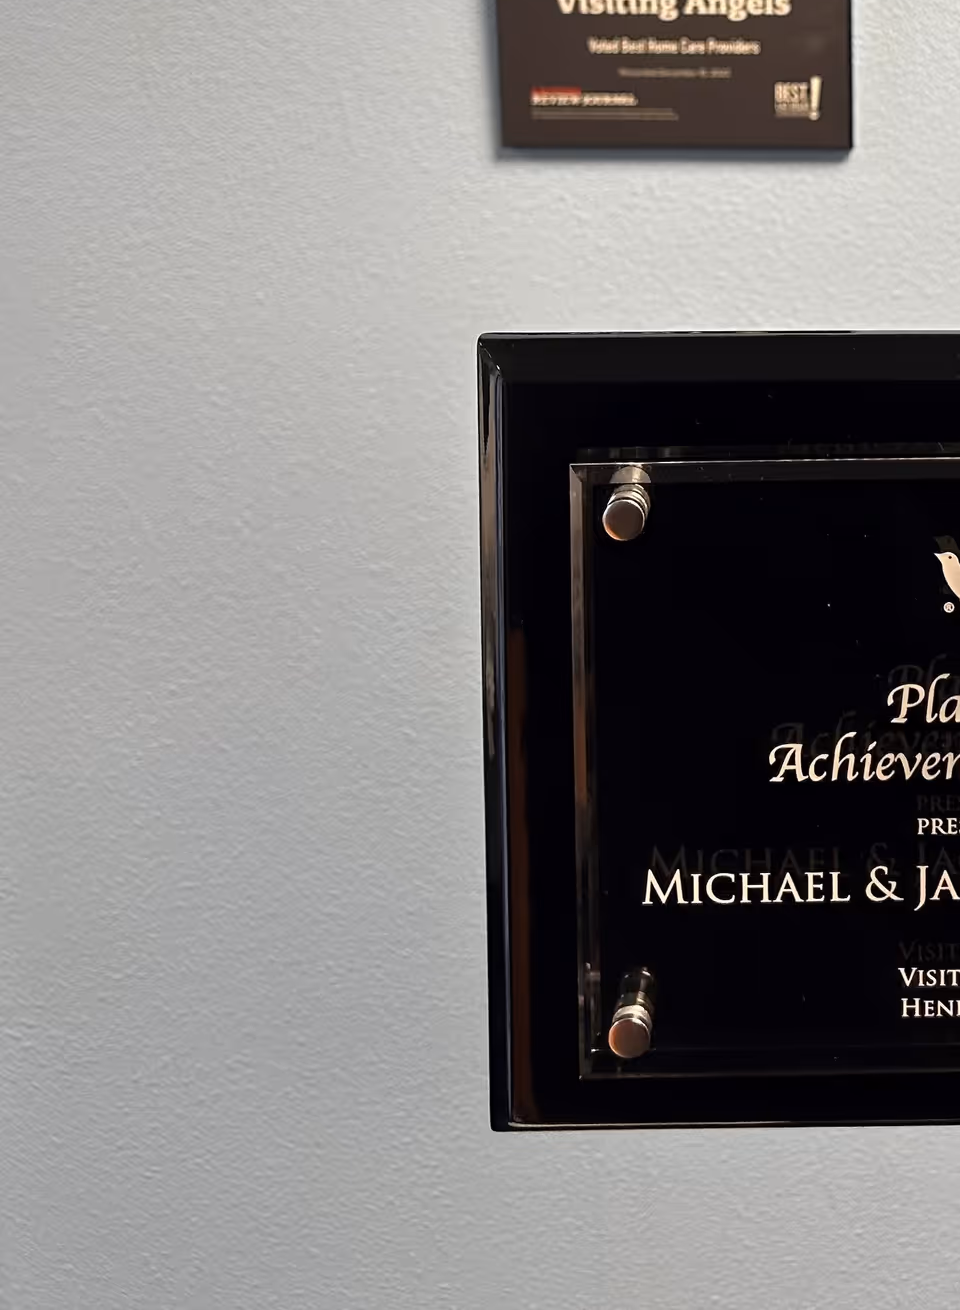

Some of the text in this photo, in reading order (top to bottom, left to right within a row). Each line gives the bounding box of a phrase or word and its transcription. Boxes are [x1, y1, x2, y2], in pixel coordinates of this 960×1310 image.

[586, 36, 762, 55] Voted Best Home Care Providers
[866, 866, 904, 901] &
